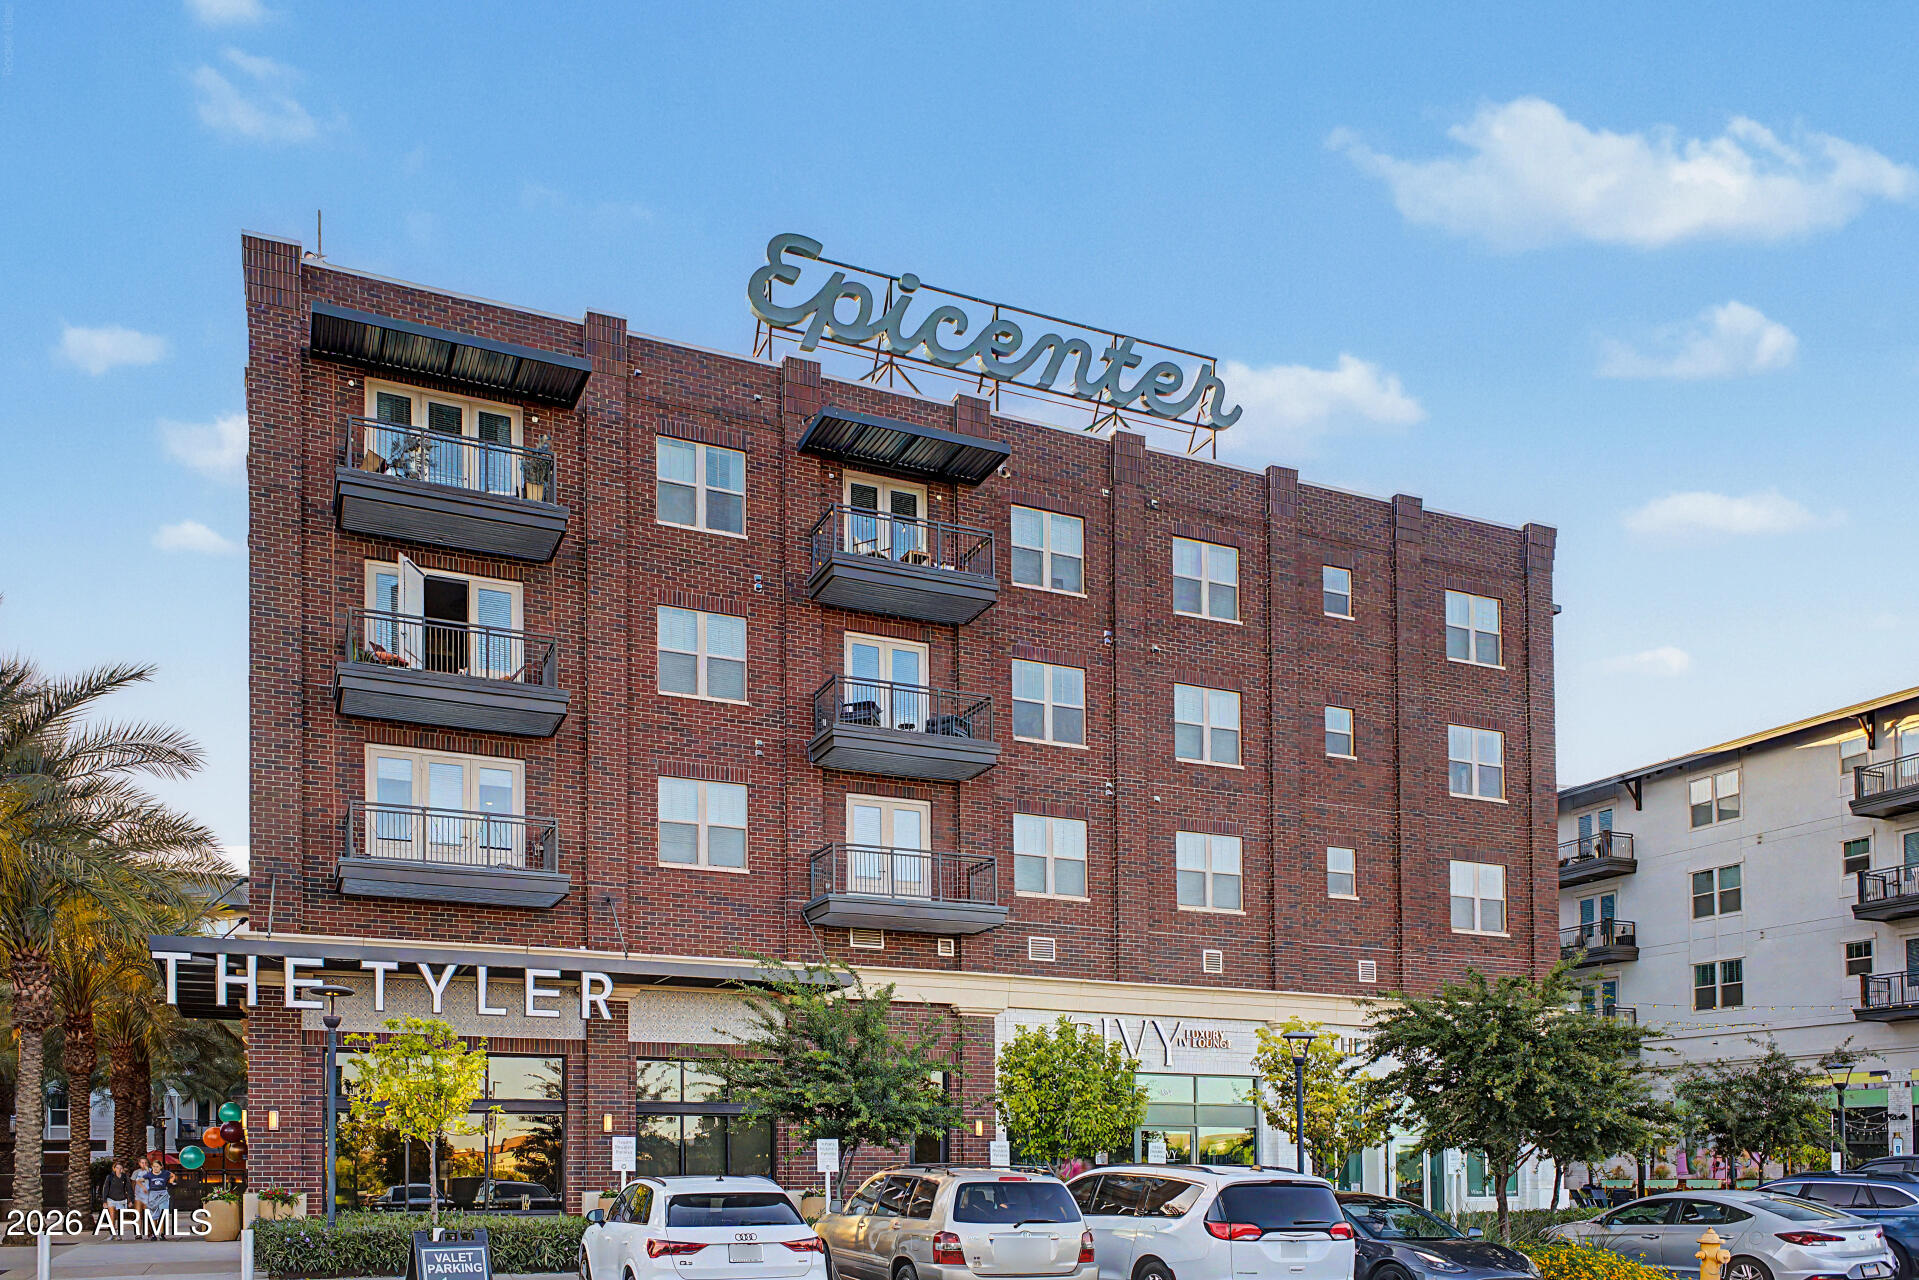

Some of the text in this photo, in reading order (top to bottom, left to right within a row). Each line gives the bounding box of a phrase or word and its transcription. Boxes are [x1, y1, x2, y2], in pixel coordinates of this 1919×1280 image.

[747, 232, 1243, 432] Epicenter
[151, 951, 614, 1021] THE TYLER
[1185, 1029, 1226, 1040] LUXURY
[1101, 1017, 1184, 1067] IVY
[1191, 1039, 1233, 1049] LOUNGE
[434, 1252, 474, 1263] VALET
[427, 1262, 484, 1274] PARKING
